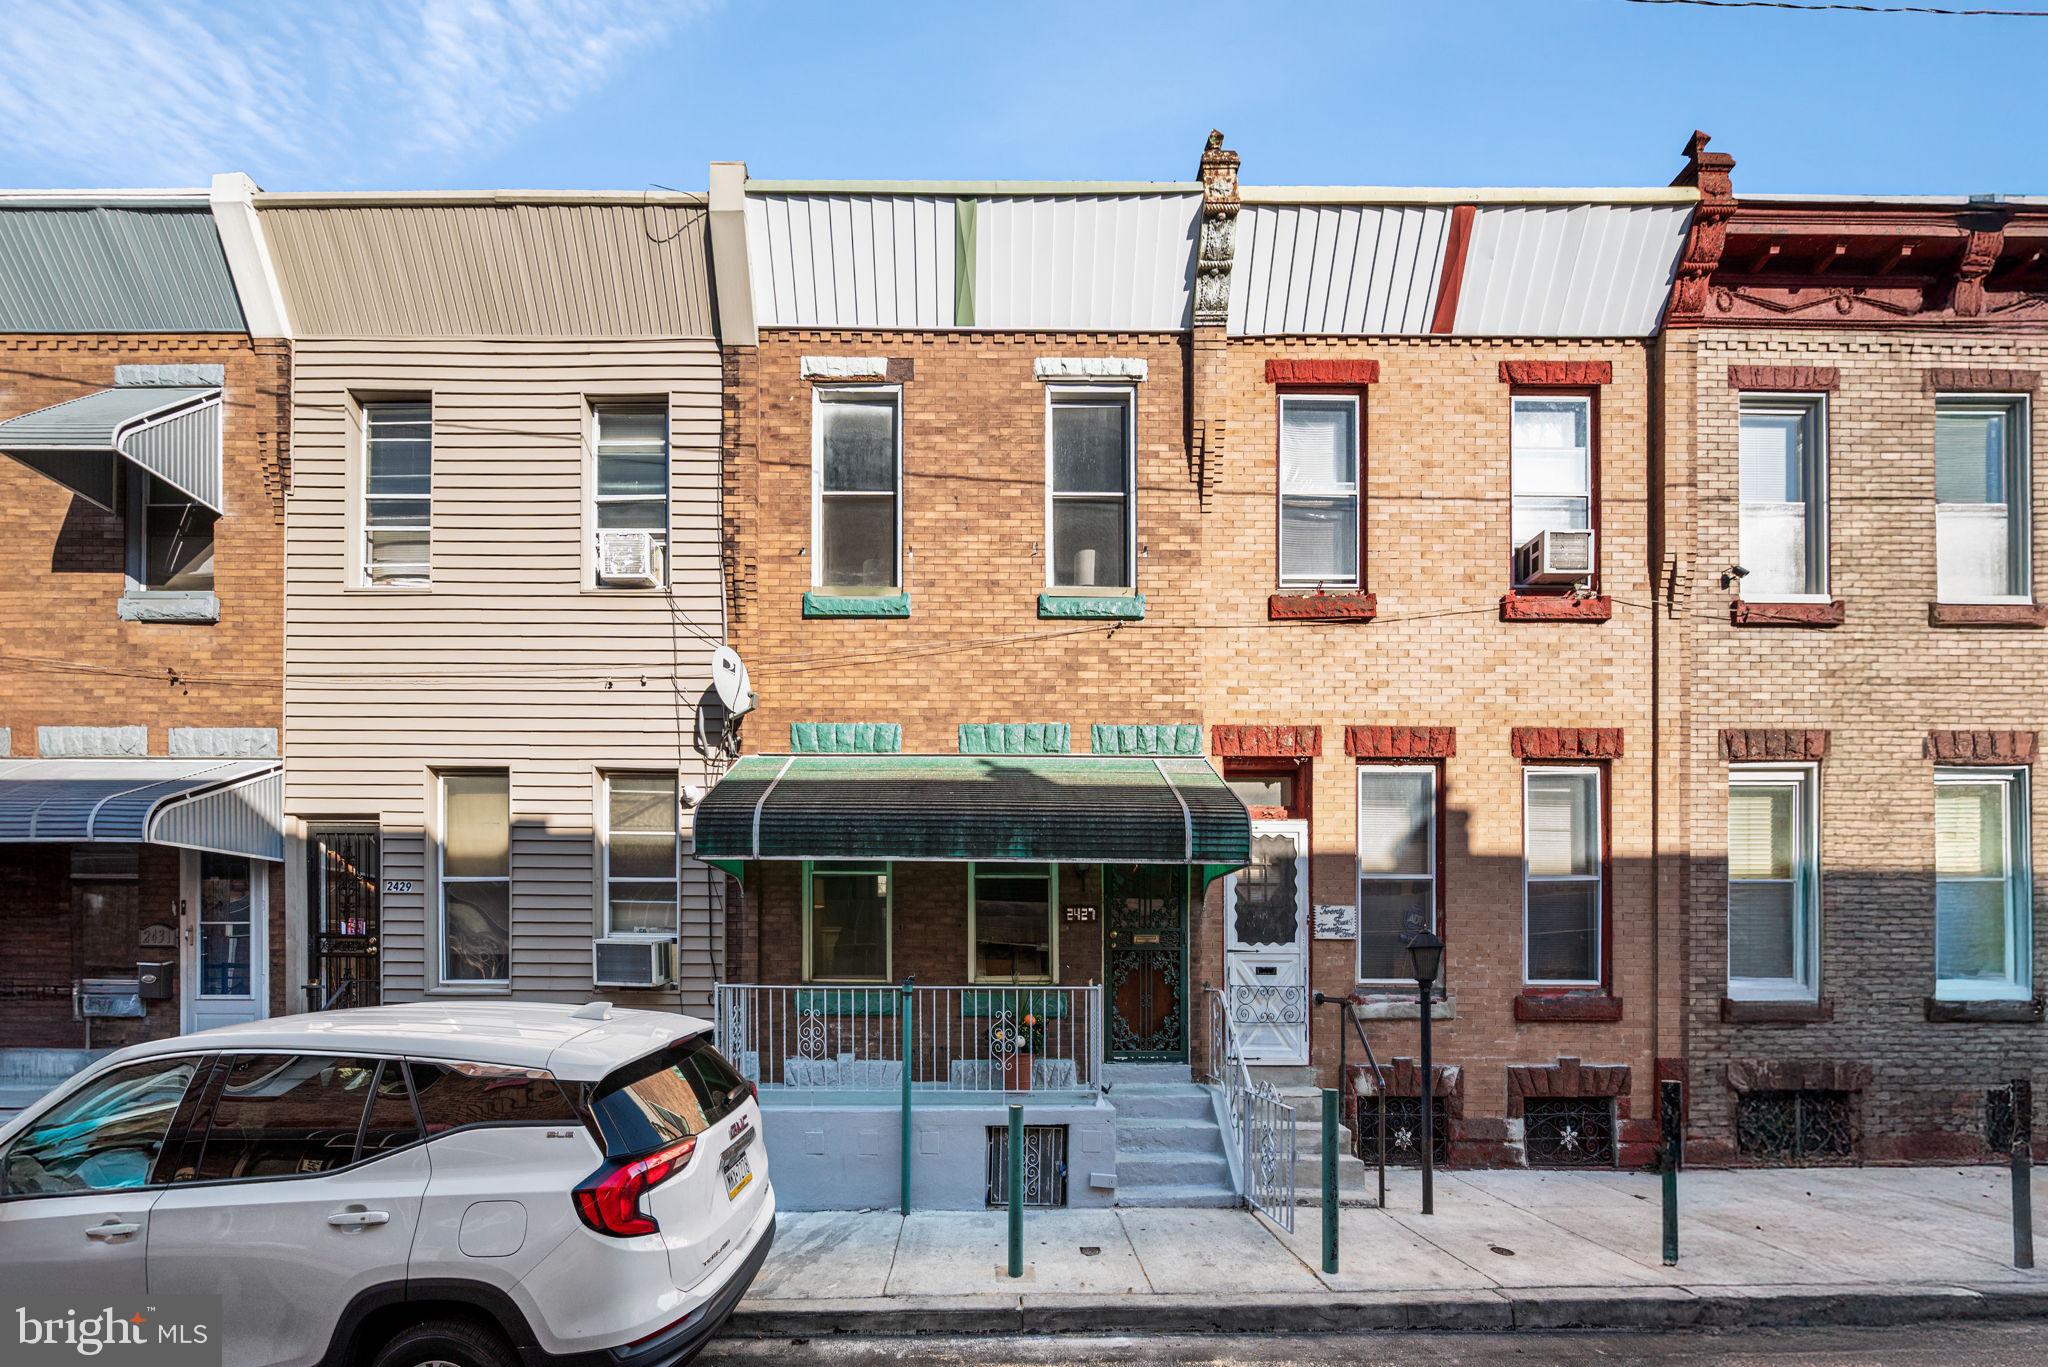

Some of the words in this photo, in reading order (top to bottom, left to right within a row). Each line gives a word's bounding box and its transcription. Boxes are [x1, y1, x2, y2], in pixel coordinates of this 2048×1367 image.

[386, 881, 412, 892] 2429
[1066, 907, 1096, 921] 2427
[1319, 905, 1346, 919] Twenty
